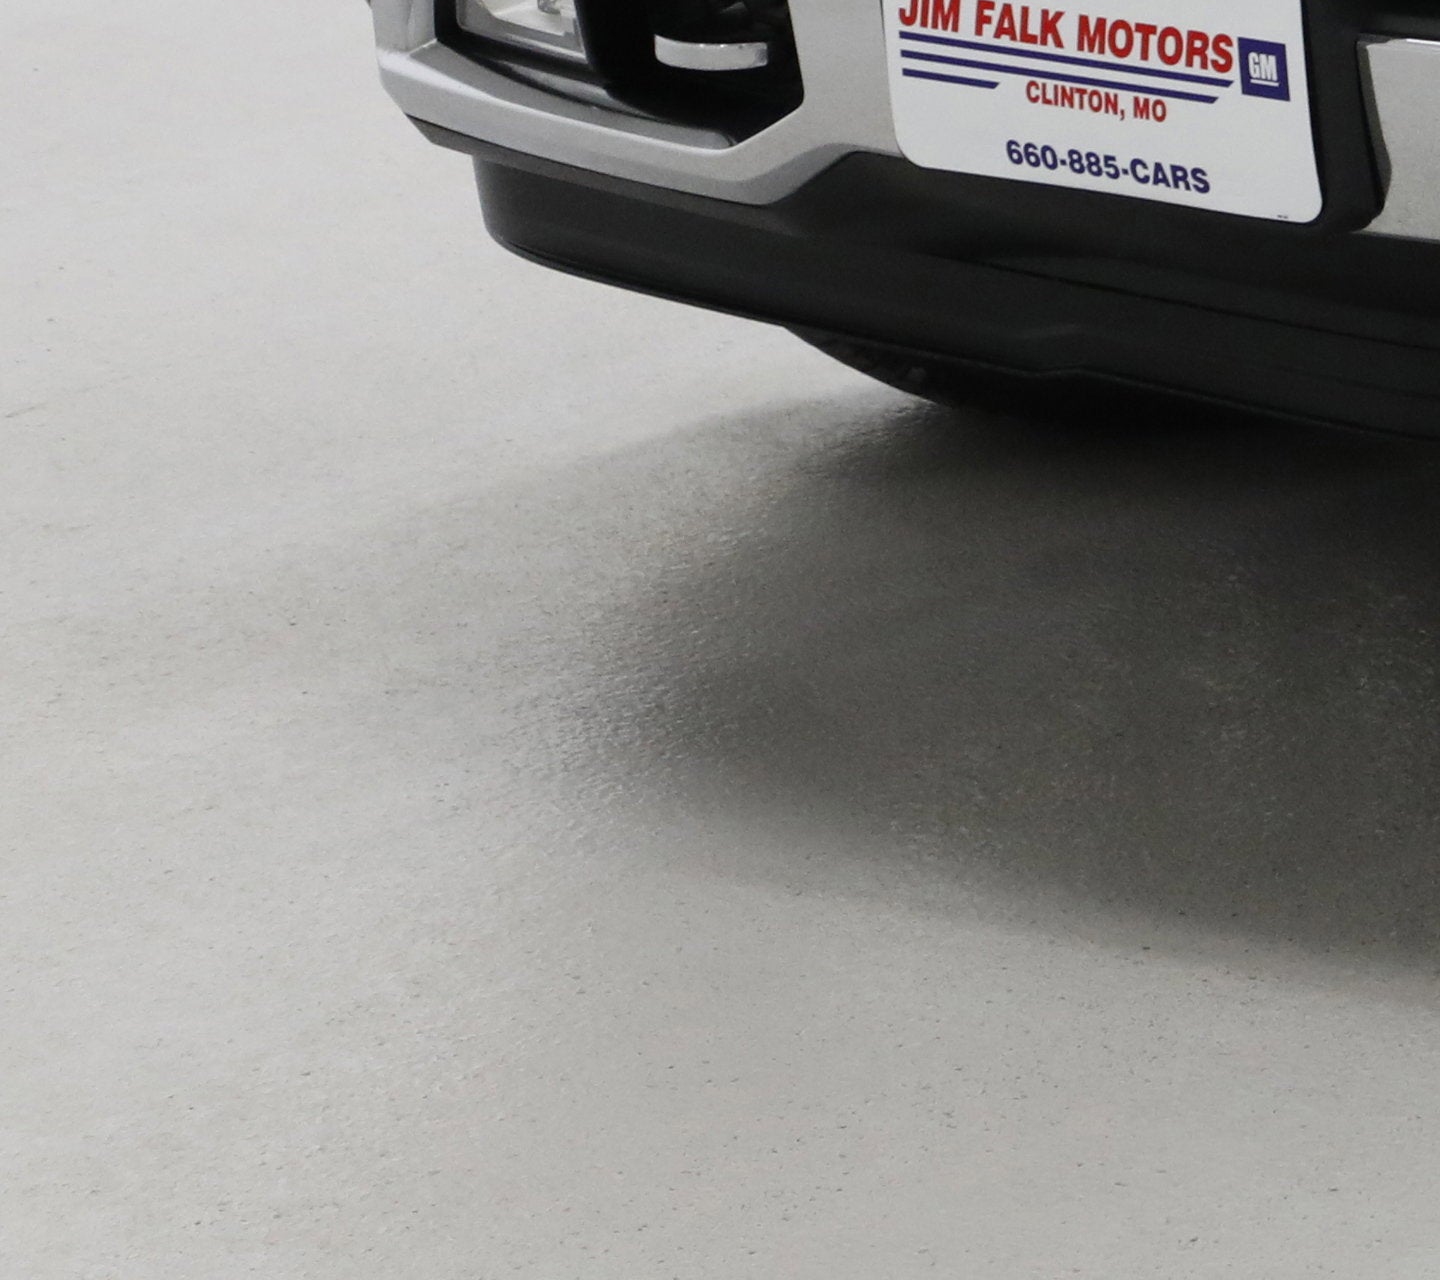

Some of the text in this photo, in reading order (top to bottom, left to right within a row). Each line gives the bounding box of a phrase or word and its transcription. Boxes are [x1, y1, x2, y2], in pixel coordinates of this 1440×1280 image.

[974, 0, 1066, 49] FALK
[1076, 14, 1235, 73] MOTORS
[1247, 51, 1279, 83] GM
[1025, 80, 1168, 123] CLINTON, MO
[1005, 139, 1211, 194] 660-885-CARS
